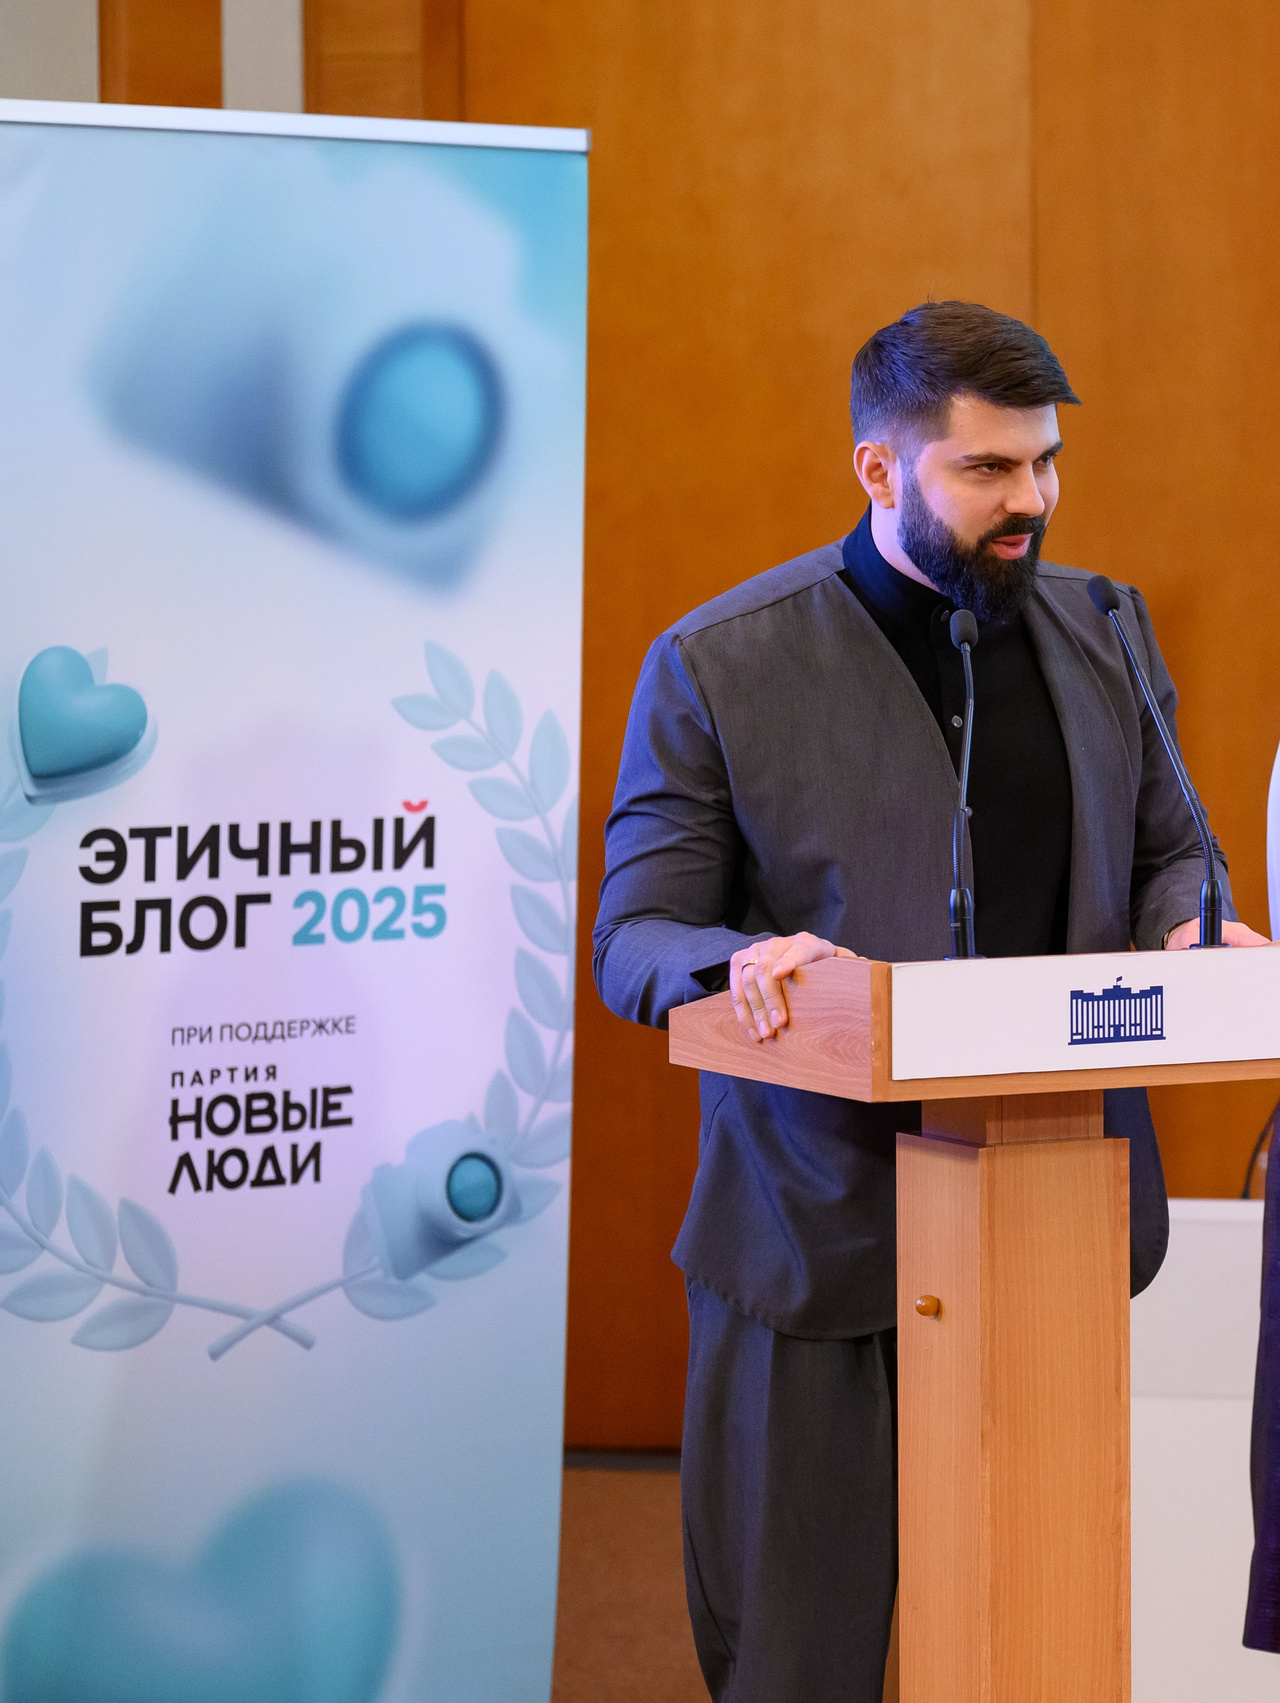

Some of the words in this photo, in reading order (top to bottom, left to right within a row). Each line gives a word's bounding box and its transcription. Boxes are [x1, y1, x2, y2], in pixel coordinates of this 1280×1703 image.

[78, 800, 437, 885] ЭТИЧНЫЙ
[79, 893, 272, 958] БЛОГ
[291, 884, 448, 947] 2025
[171, 1026, 213, 1047] ПРИ
[220, 1015, 357, 1045] ПОДДЕРЖКЕ
[171, 1065, 278, 1088] ПАРТИЯ
[169, 1085, 354, 1141] НОВЫЕ
[168, 1142, 322, 1195] ЛЮДИ
